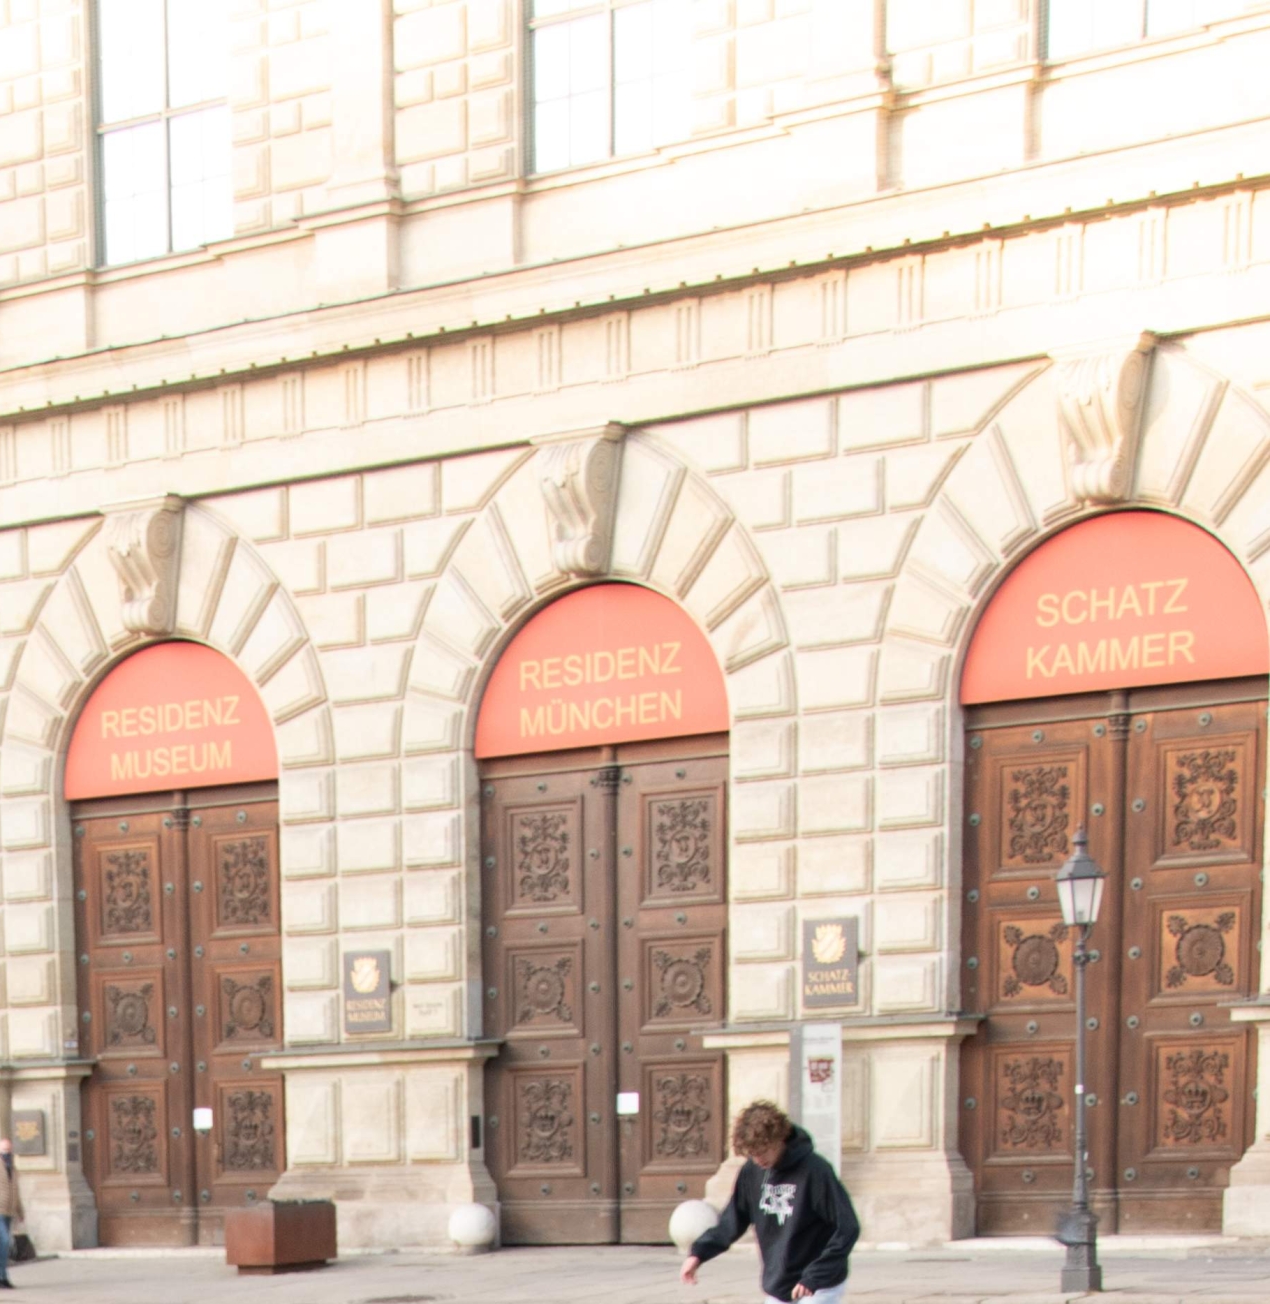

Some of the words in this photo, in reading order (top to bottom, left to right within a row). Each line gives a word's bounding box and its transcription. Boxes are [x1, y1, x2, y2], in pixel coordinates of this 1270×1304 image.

[1037, 578, 1188, 627] SCHATZ
[519, 641, 682, 692] RESIDENZ
[1026, 630, 1195, 679] KAMMER
[101, 695, 240, 739] RESIDENZ
[520, 689, 683, 738] MÜNCHEN
[111, 741, 233, 781] MUSEUM
